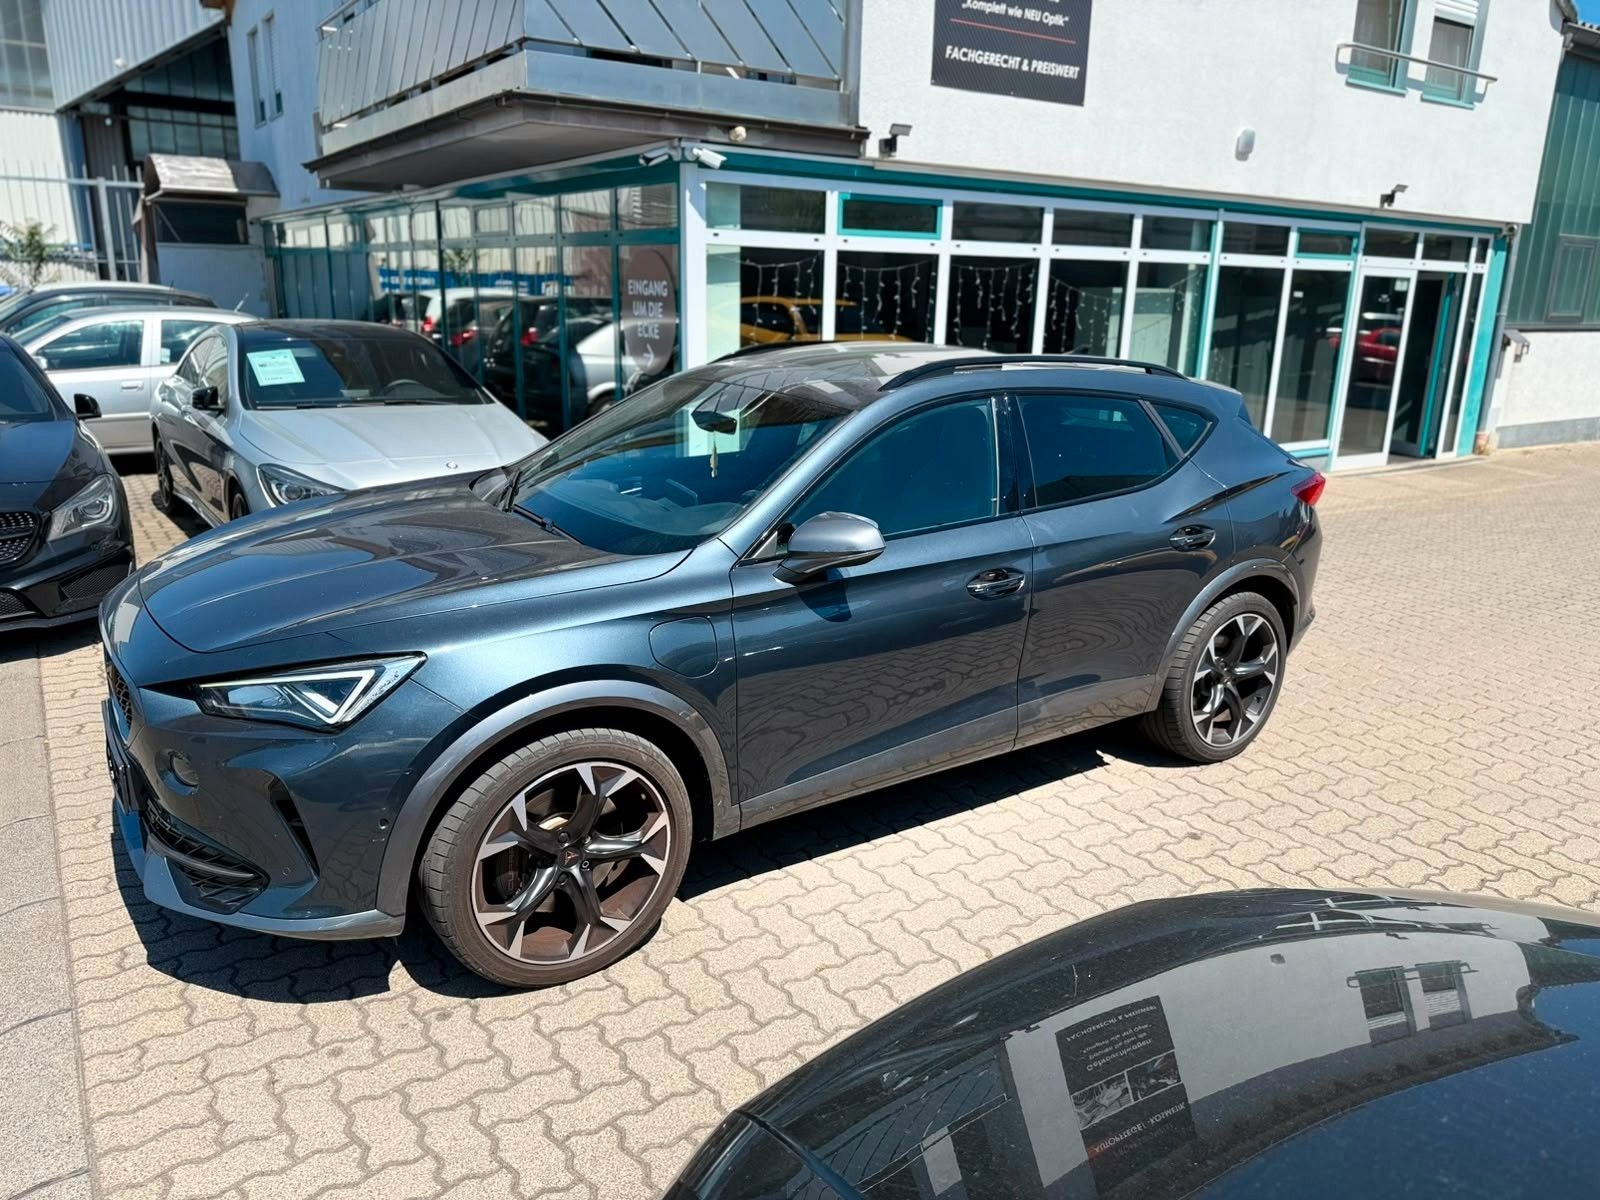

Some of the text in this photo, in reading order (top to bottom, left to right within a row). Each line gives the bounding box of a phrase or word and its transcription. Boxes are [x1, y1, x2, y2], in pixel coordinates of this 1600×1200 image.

[1008, 6, 1023, 18] wie
[1024, 8, 1042, 22] NEU
[945, 45, 1080, 79] FACHGERECHT & PREISWERT
[628, 280, 668, 297] EINGANG
[632, 301, 663, 318] UM DIE
[638, 323, 660, 339] ECKE
